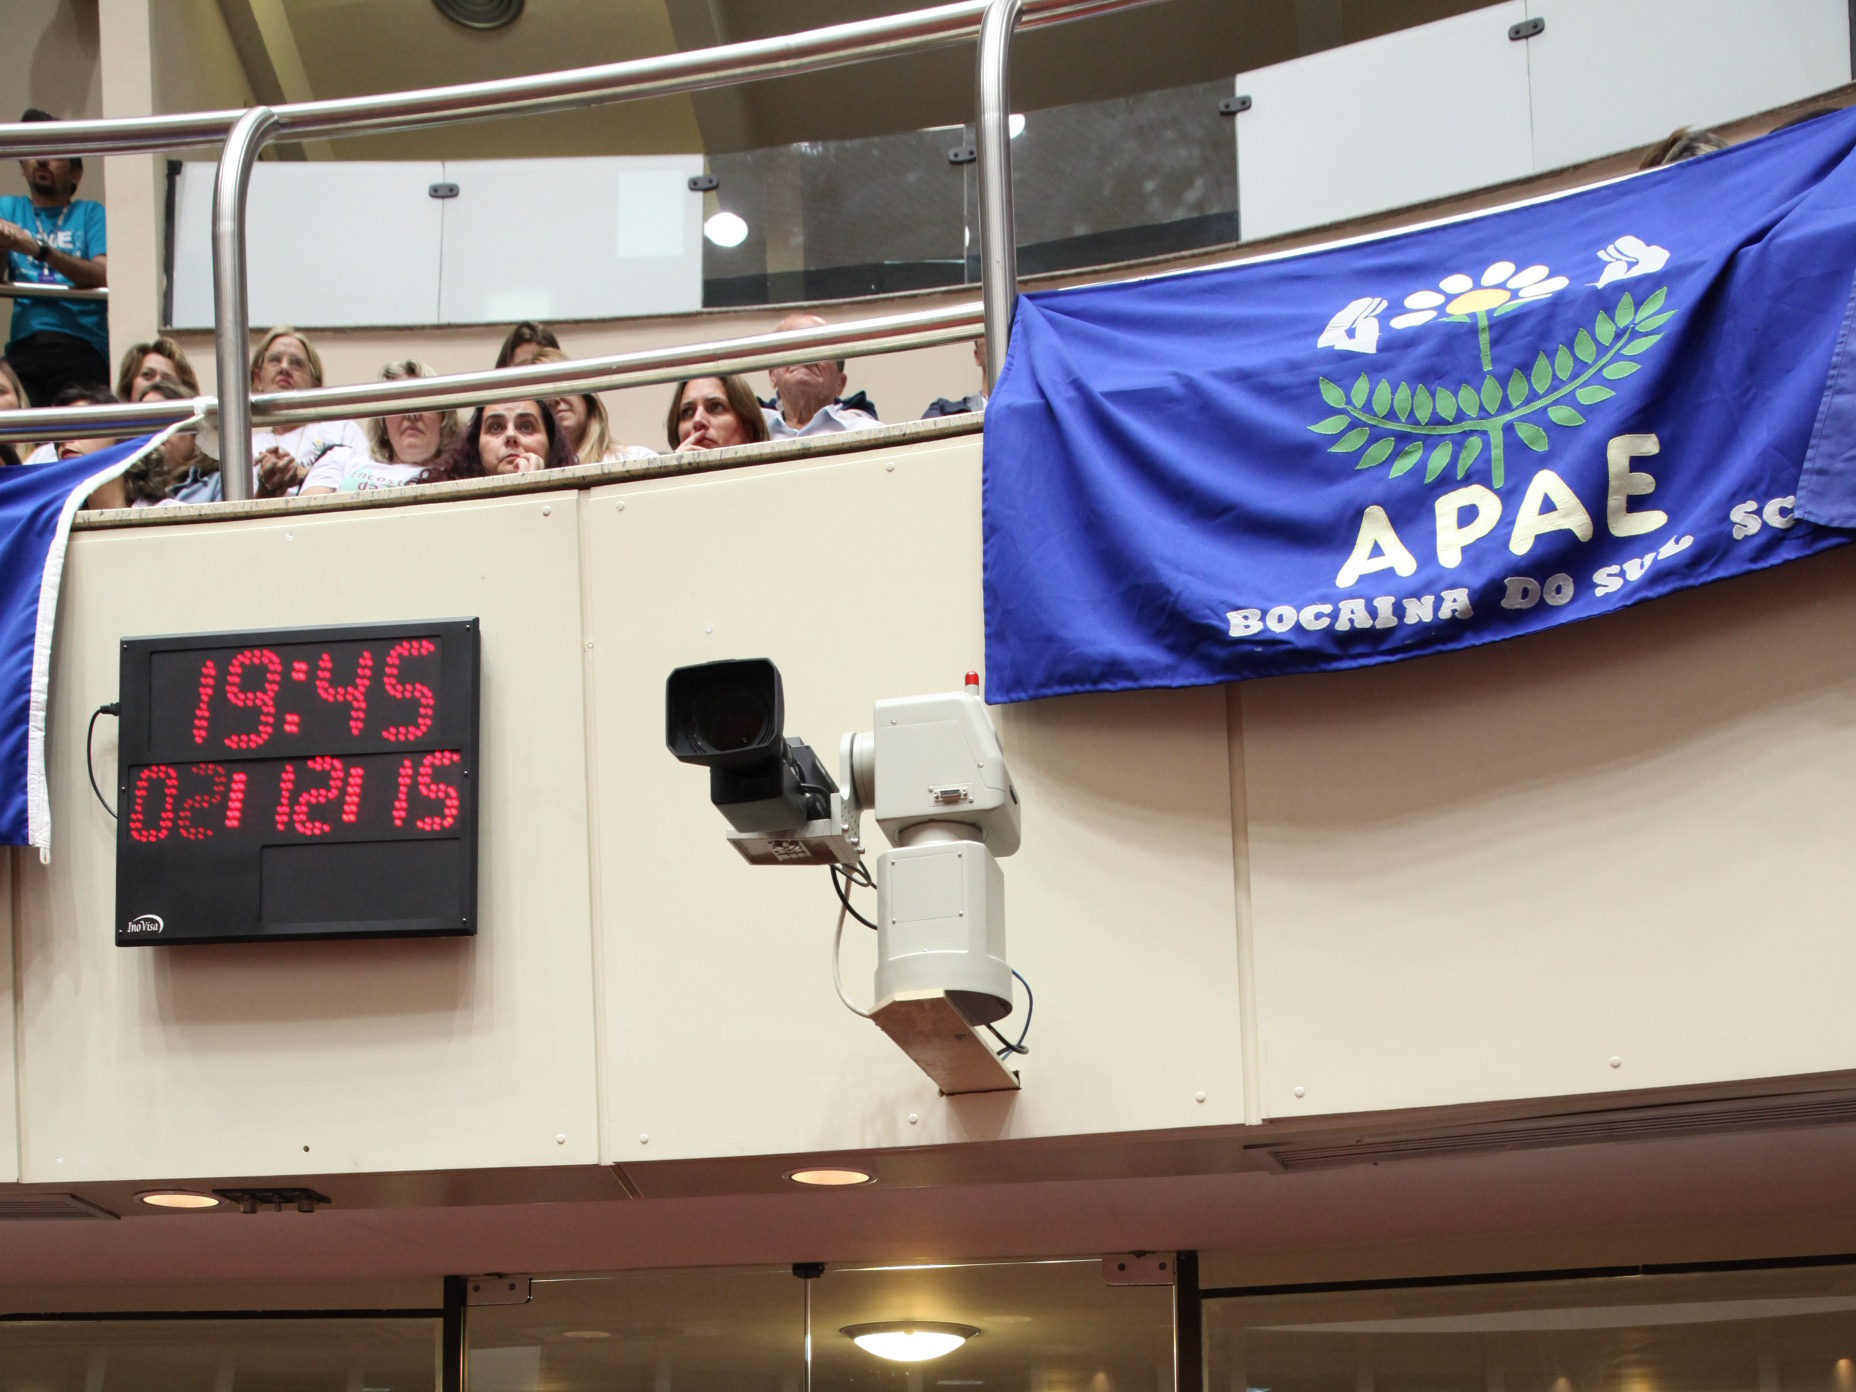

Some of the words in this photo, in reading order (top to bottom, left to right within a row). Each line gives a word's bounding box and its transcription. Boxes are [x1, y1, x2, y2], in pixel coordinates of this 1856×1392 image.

[1226, 588, 1474, 638] BOCAINA
[1501, 572, 1575, 610] DO
[1594, 534, 1694, 597] SUL
[1729, 495, 1796, 541] SC
[1336, 433, 1668, 588] APAE
[192, 639, 436, 749] 19:45
